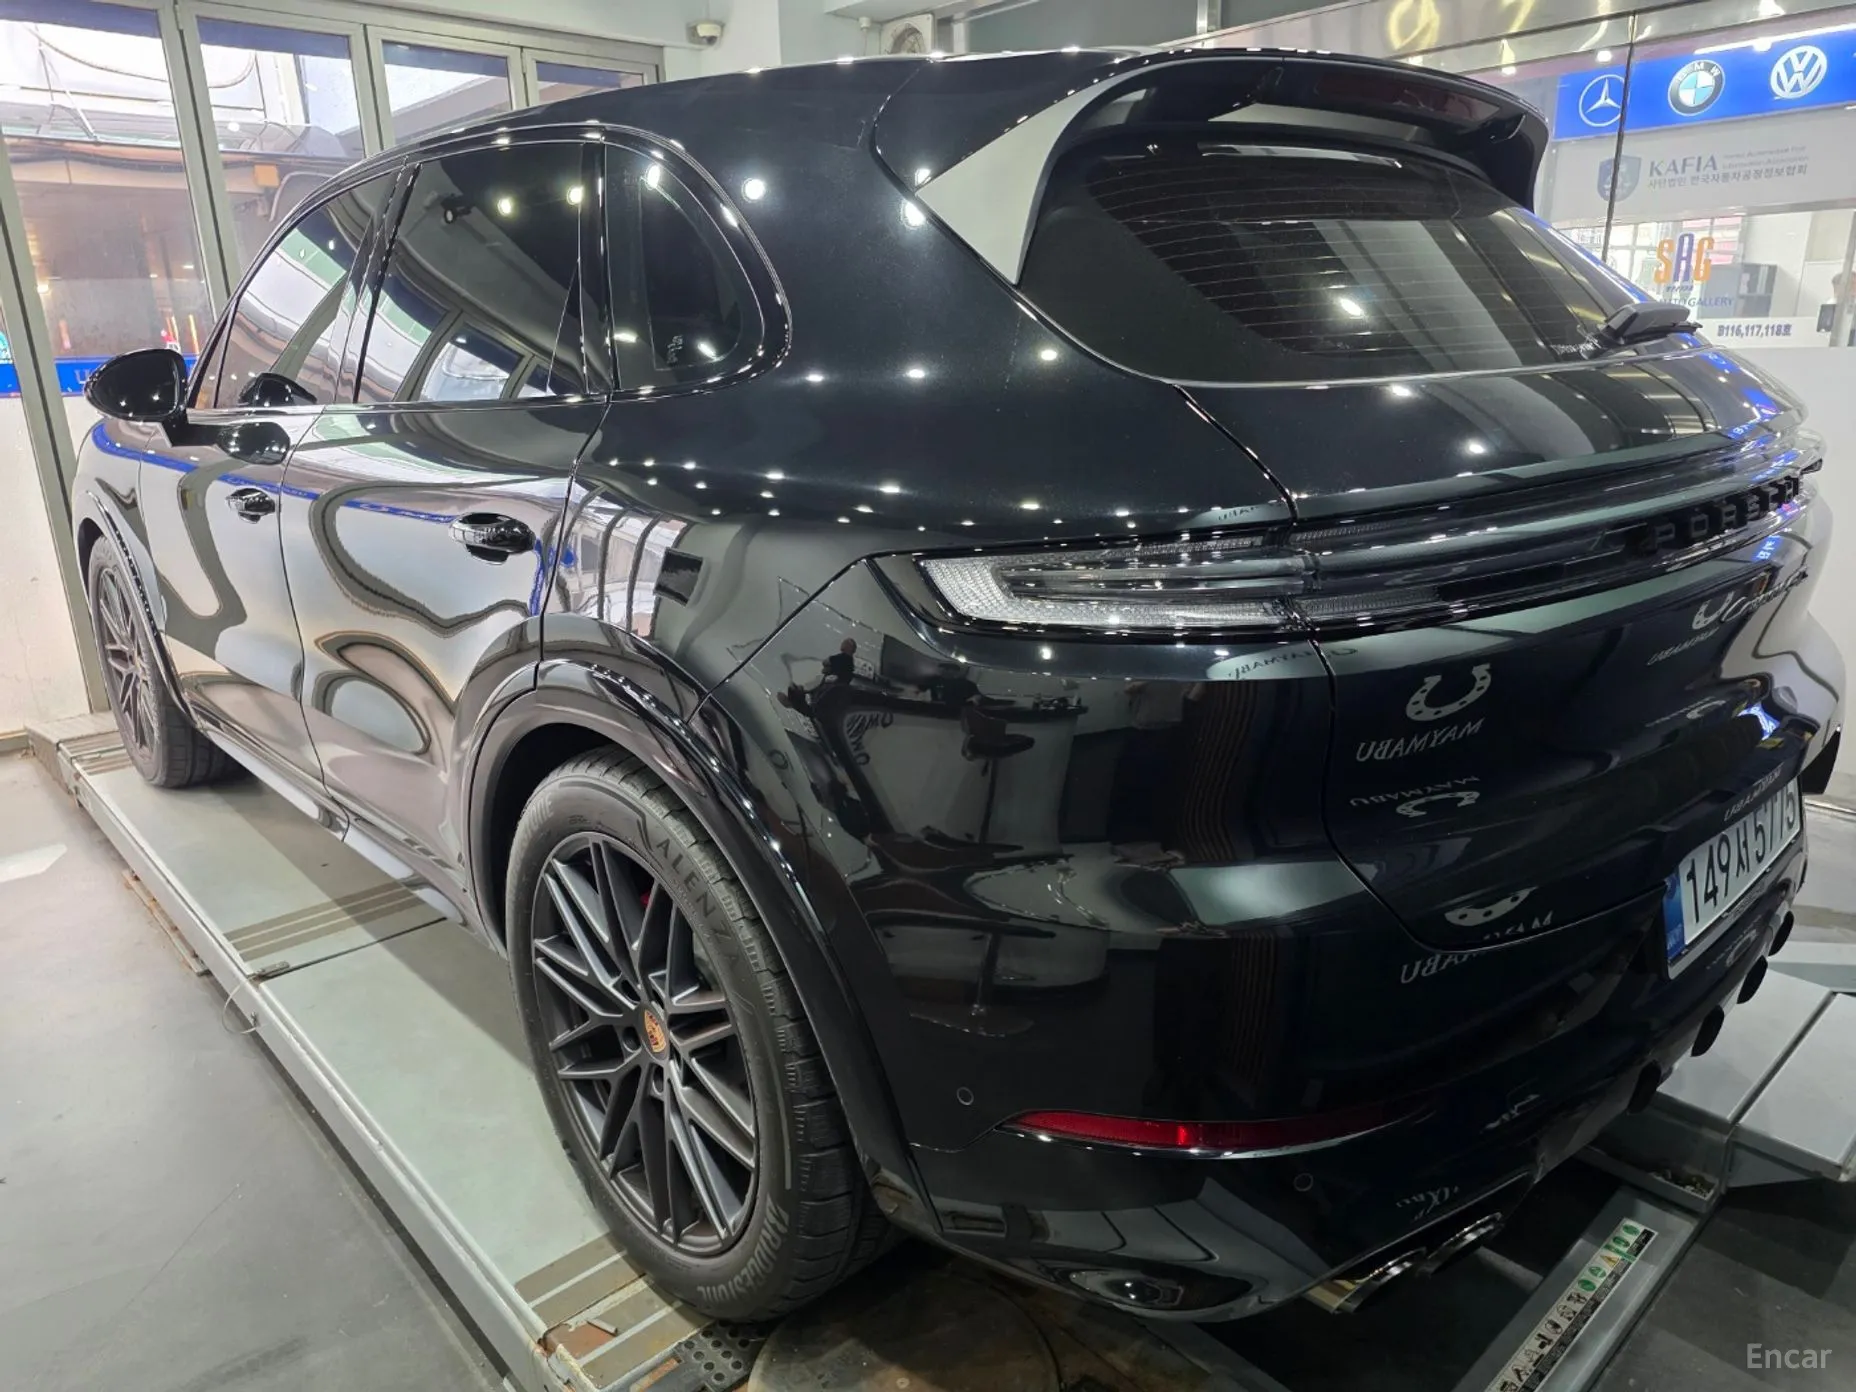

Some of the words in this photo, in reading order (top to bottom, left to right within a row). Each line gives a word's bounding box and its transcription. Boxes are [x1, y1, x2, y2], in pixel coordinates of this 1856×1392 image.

[1649, 155, 1718, 179] KAFIA
[1653, 475, 1800, 550] PORSCH
[656, 838, 739, 970] ALENZA
[1686, 822, 1750, 924] 149서
